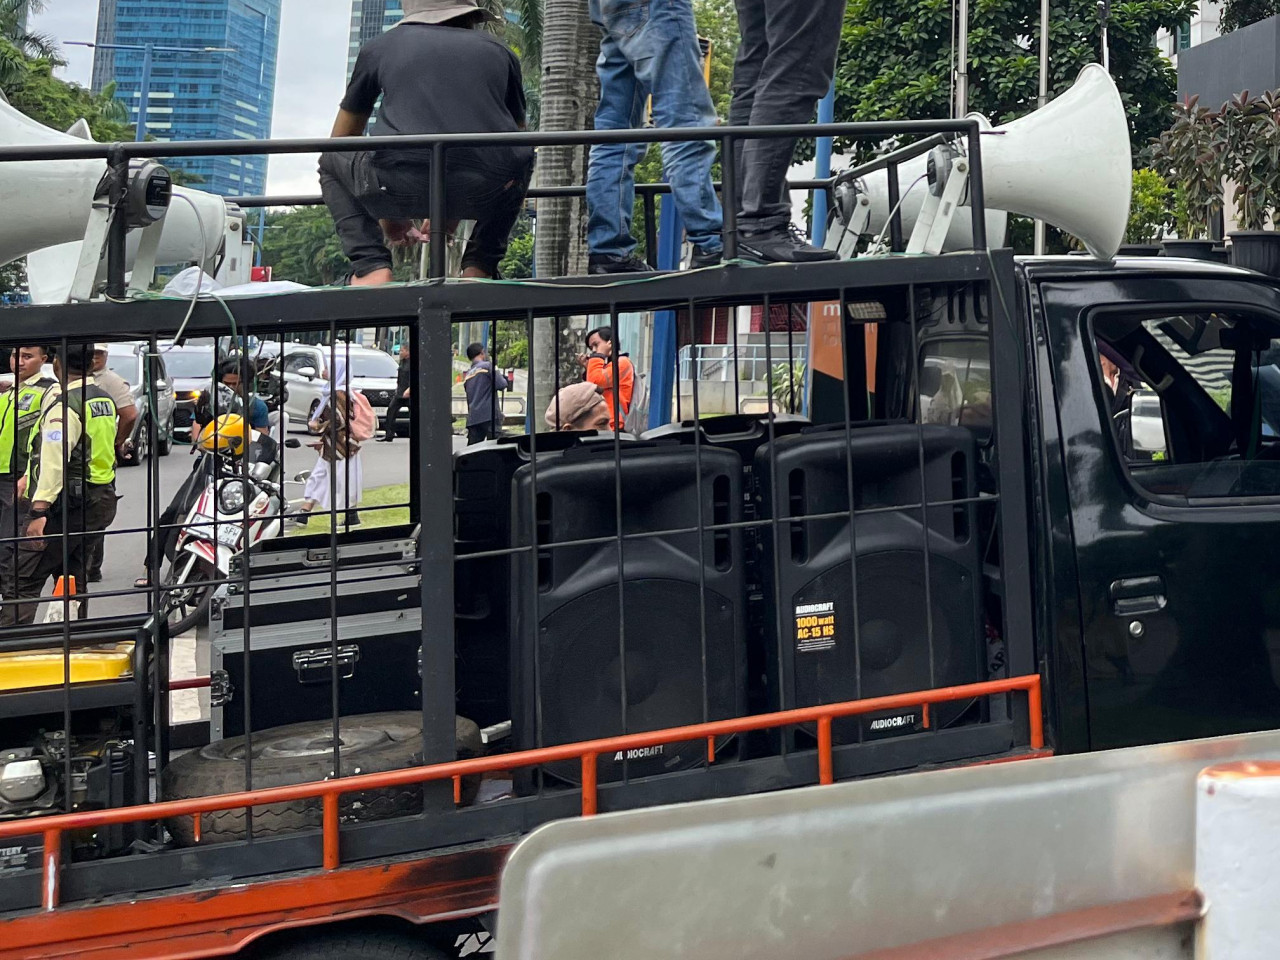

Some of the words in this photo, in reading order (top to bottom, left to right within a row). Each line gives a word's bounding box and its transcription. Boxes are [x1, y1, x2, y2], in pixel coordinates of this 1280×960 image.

[796, 602, 833, 614] AUDIOCRAFT
[796, 616, 818, 628] 1000
[818, 616, 834, 625] watt
[798, 627, 821, 639] AC-15
[823, 625, 834, 636] HS
[870, 715, 914, 729] AUDIOCRAFT
